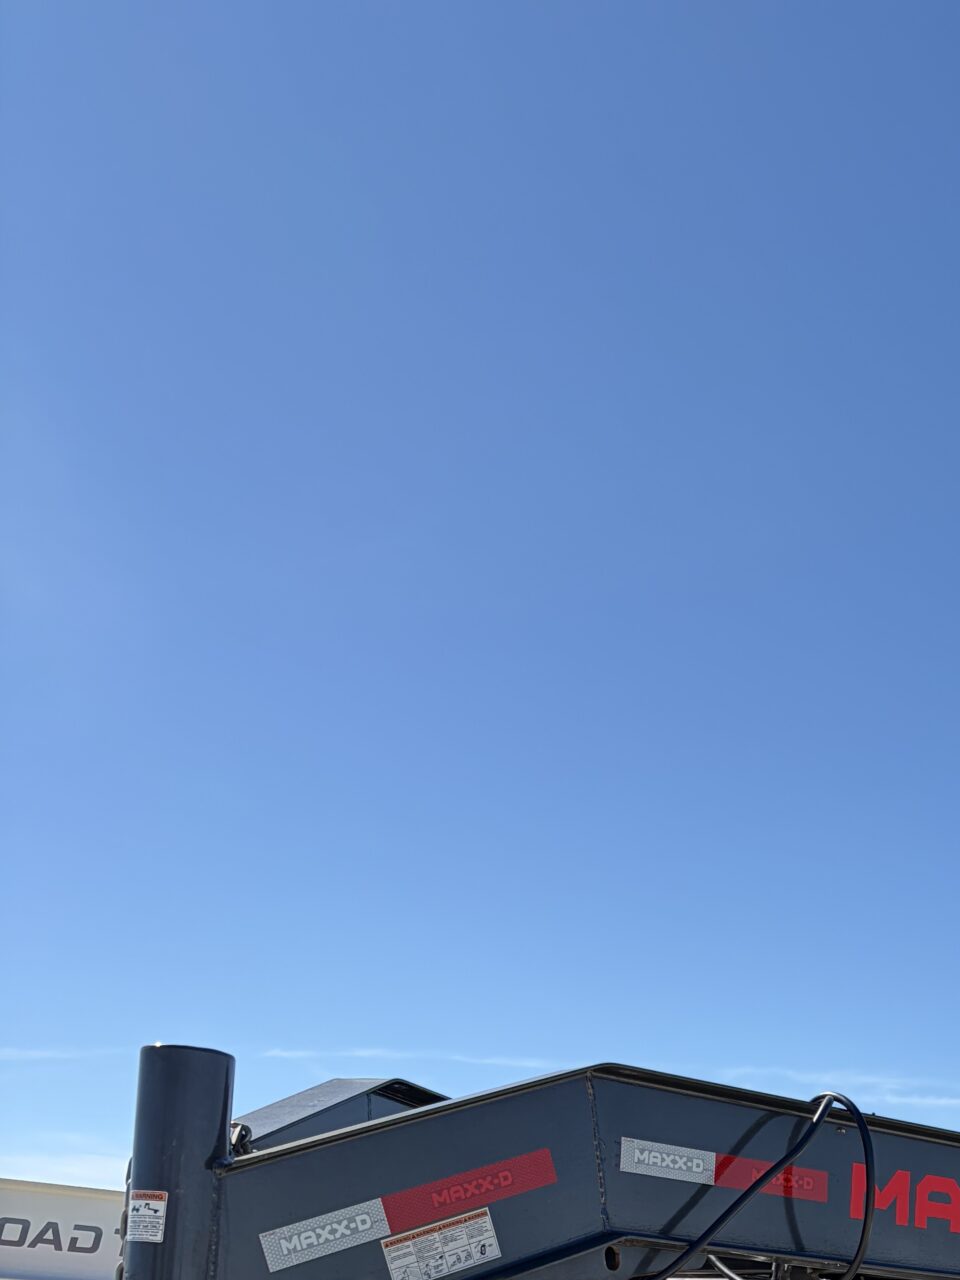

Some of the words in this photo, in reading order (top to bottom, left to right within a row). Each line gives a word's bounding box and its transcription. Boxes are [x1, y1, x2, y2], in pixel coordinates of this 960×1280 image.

[633, 1149, 704, 1172] MAXX-D
[430, 1170, 513, 1207] MAXX-D
[280, 1214, 373, 1255] MAXX-D
